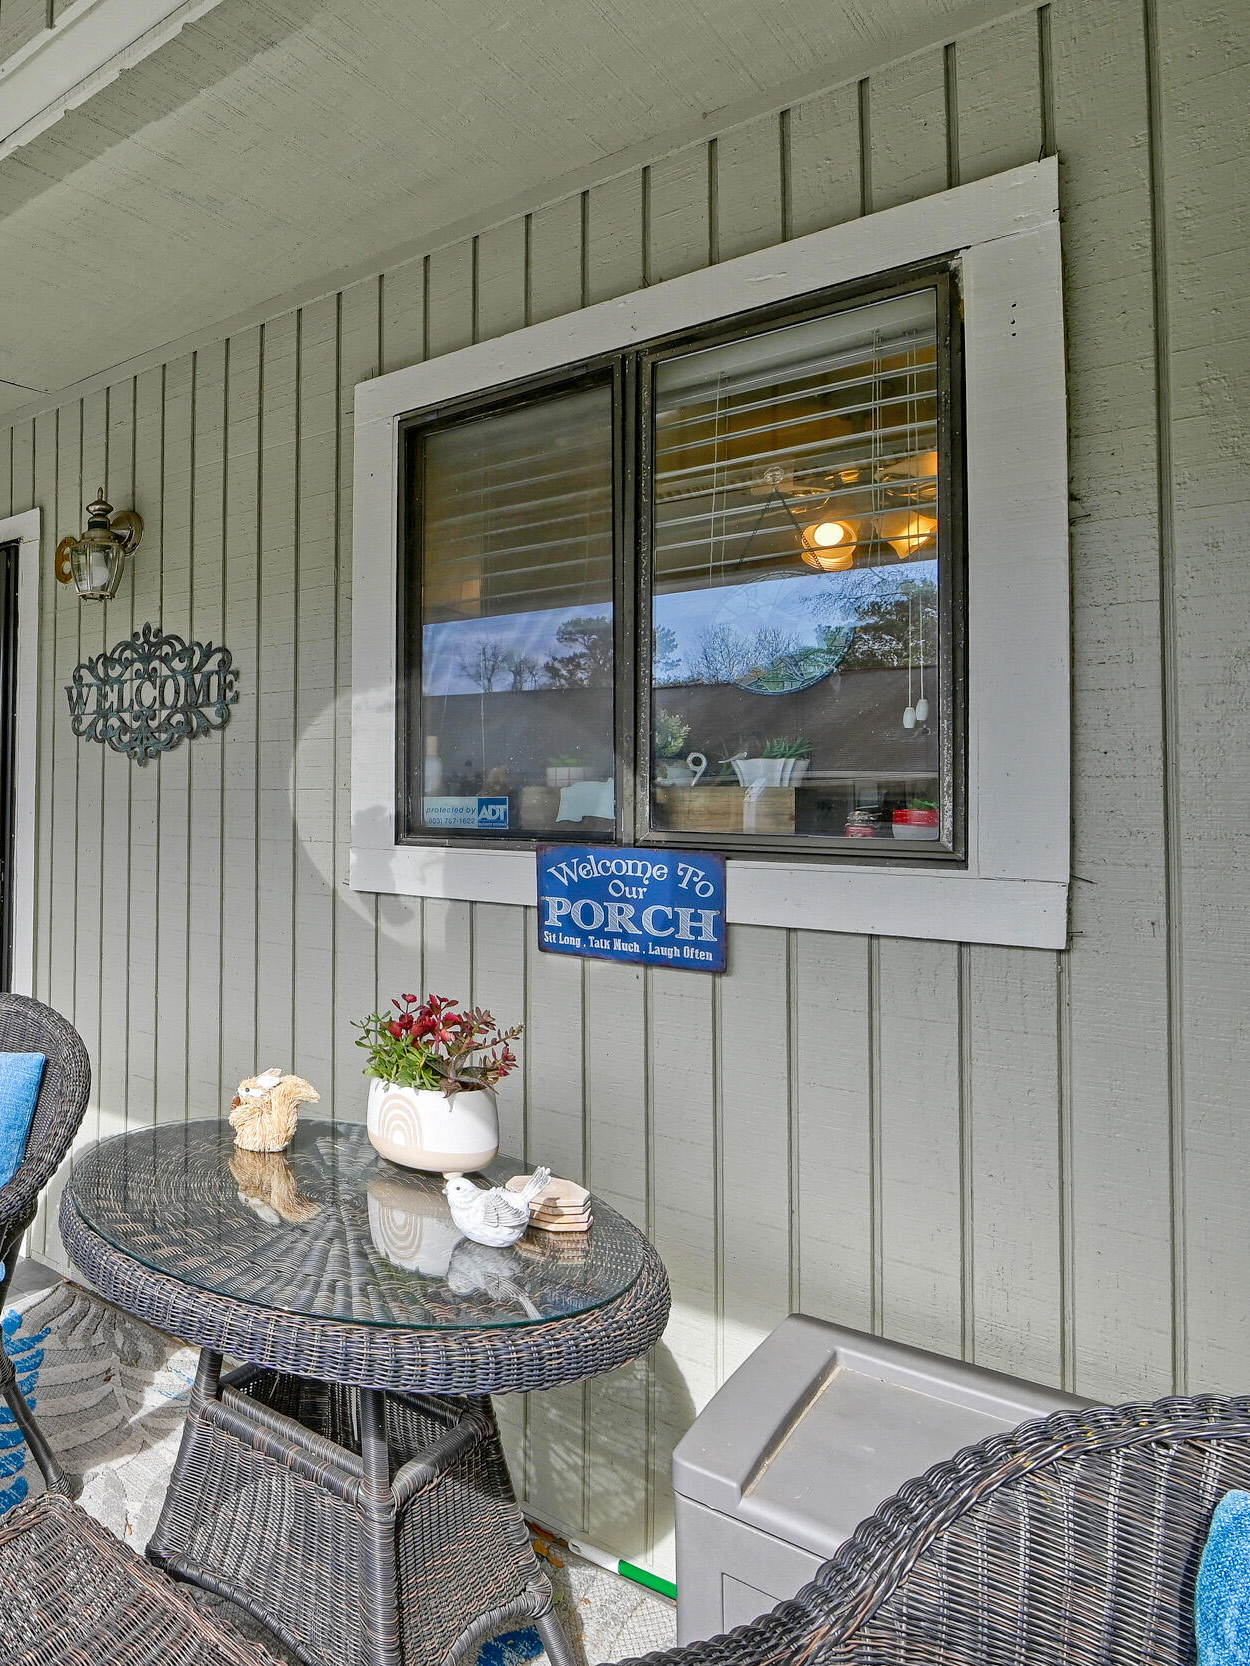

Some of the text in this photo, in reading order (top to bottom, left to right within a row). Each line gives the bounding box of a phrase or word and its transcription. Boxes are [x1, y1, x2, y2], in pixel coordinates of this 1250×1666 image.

[64, 669, 240, 716] WELCOME
[466, 807, 476, 815] by
[479, 805, 507, 820] ADT
[547, 855, 715, 898] Welcome To
[608, 879, 648, 900] Our
[540, 895, 721, 942] PORCH
[543, 930, 713, 961] Sit Long Talk Much Laugh Often
